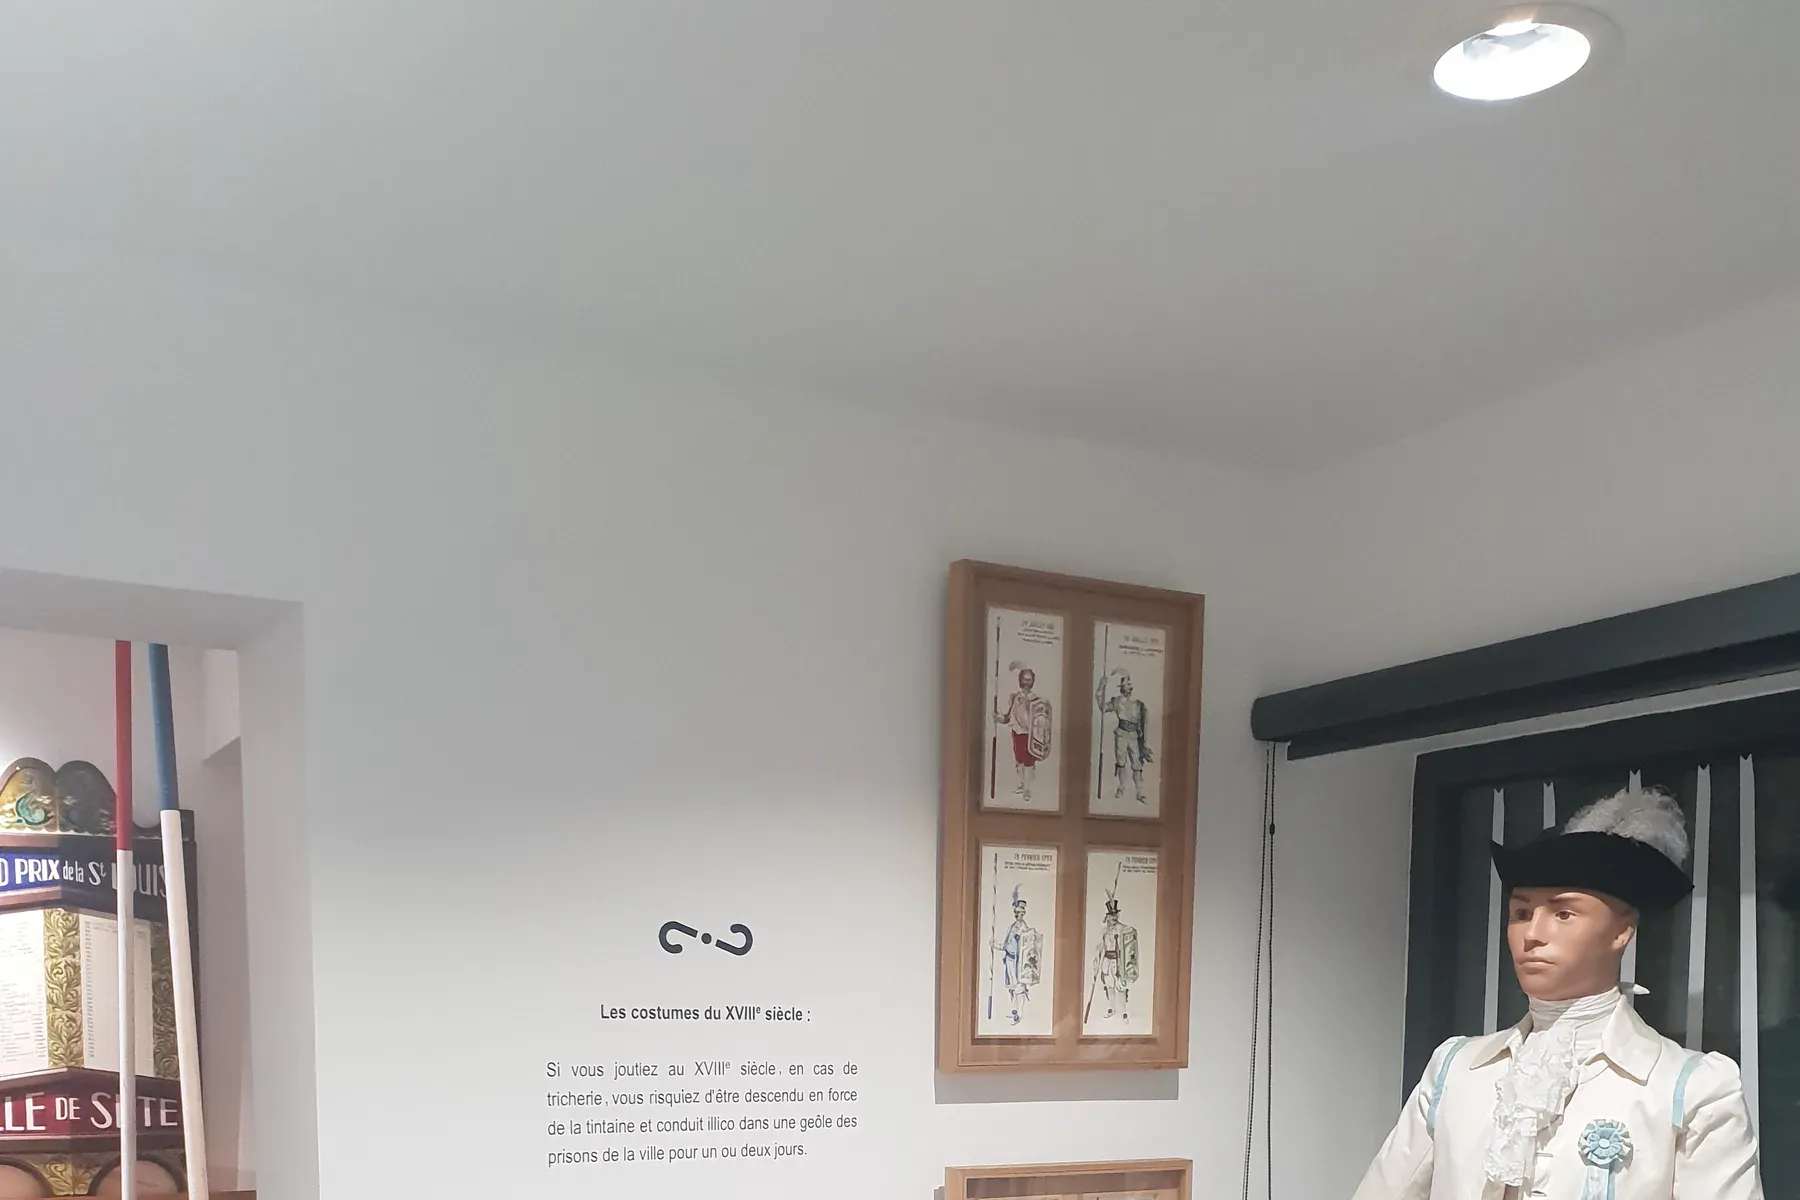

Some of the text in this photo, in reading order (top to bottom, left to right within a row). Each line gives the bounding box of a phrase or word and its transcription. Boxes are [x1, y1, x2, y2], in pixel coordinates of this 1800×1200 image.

[14, 858, 60, 885] PRIX
[600, 1003, 627, 1020] Les
[630, 1005, 700, 1021] costumes
[703, 1005, 722, 1021] du
[546, 1061, 561, 1078] Si
[570, 1065, 605, 1077] vous
[613, 1061, 659, 1081] joutiez
[668, 1064, 685, 1077] au
[788, 1064, 804, 1076] en
[812, 1064, 835, 1076] cas
[842, 1060, 858, 1076] de
[55, 1097, 81, 1121] DE
[611, 1093, 644, 1105] vous
[649, 1088, 701, 1108] risquiez
[704, 1088, 740, 1104] d'être
[744, 1087, 804, 1103] descendu
[808, 1090, 824, 1102] en
[827, 1087, 858, 1102] force
[547, 1113, 858, 1136] de la tintaine et conduit illico dans une geôle des
[548, 1141, 808, 1169] prisons de la ville pour un ou deux jours.
